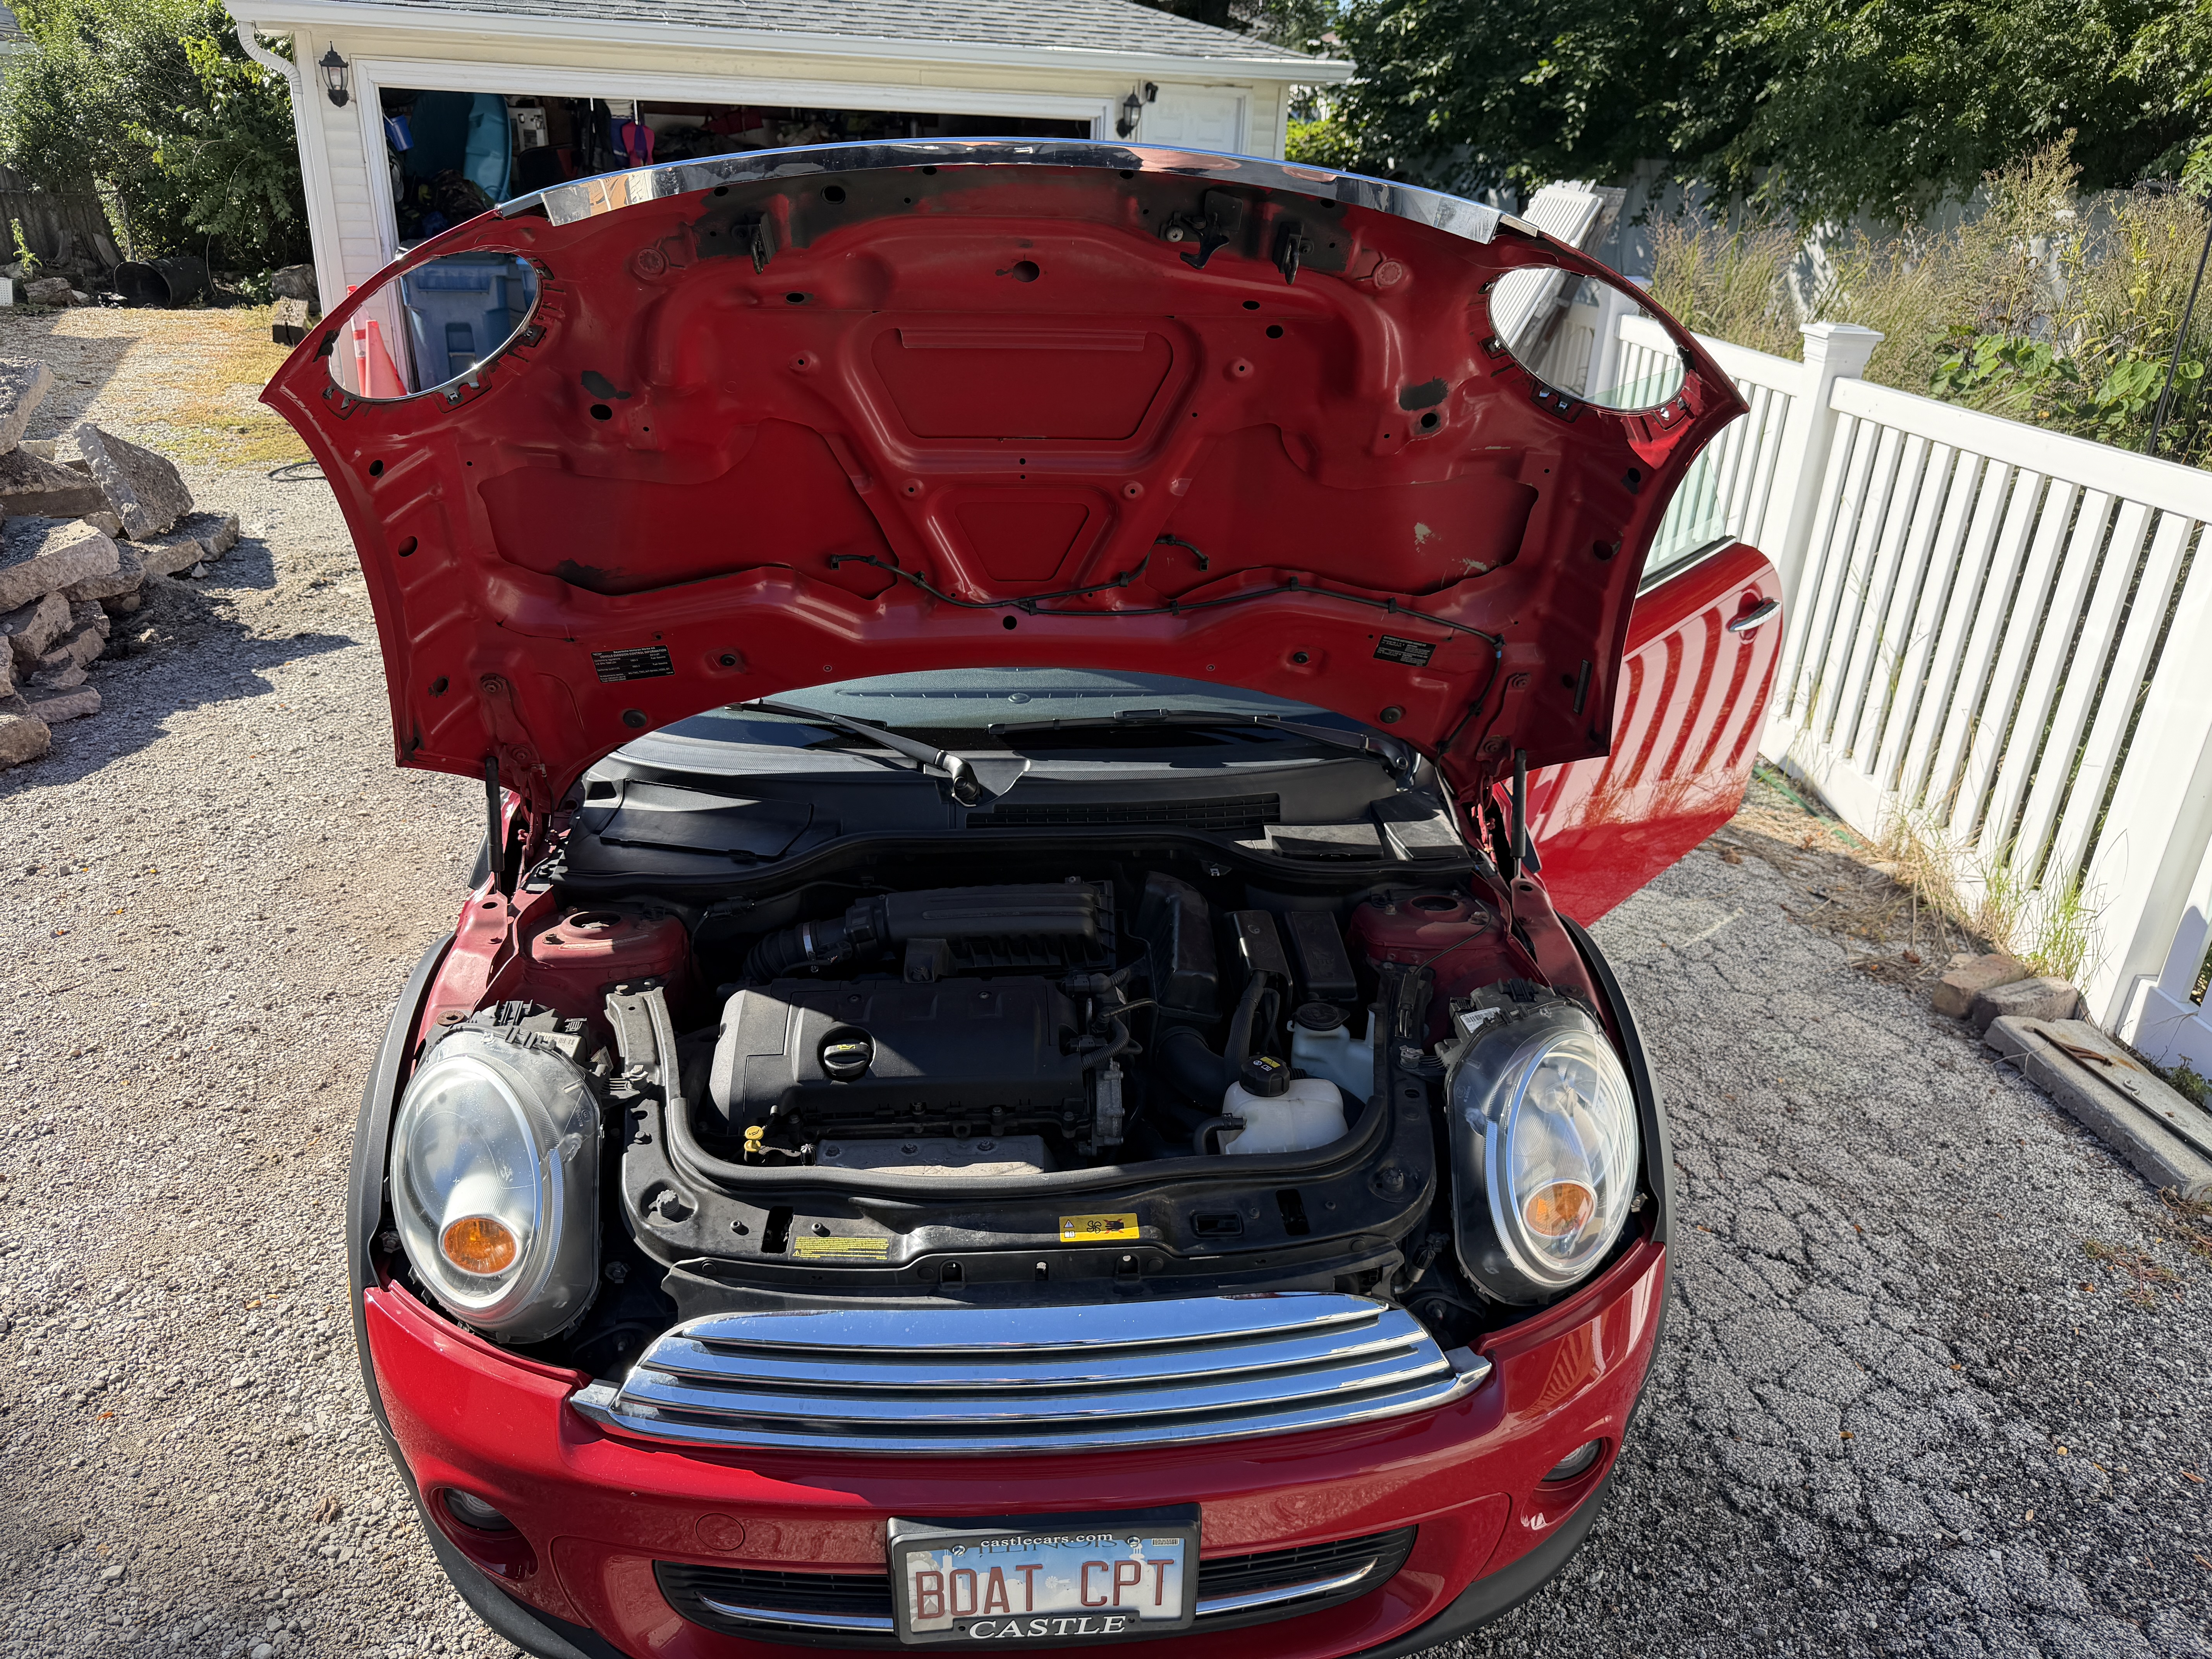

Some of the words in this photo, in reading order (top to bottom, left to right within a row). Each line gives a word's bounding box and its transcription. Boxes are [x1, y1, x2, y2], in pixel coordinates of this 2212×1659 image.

[981, 1534, 1113, 1547] castlecars.com
[916, 1564, 1043, 1620] BOAT
[1080, 1559, 1175, 1607] CPT
[969, 1615, 1127, 1639] CASTLE
